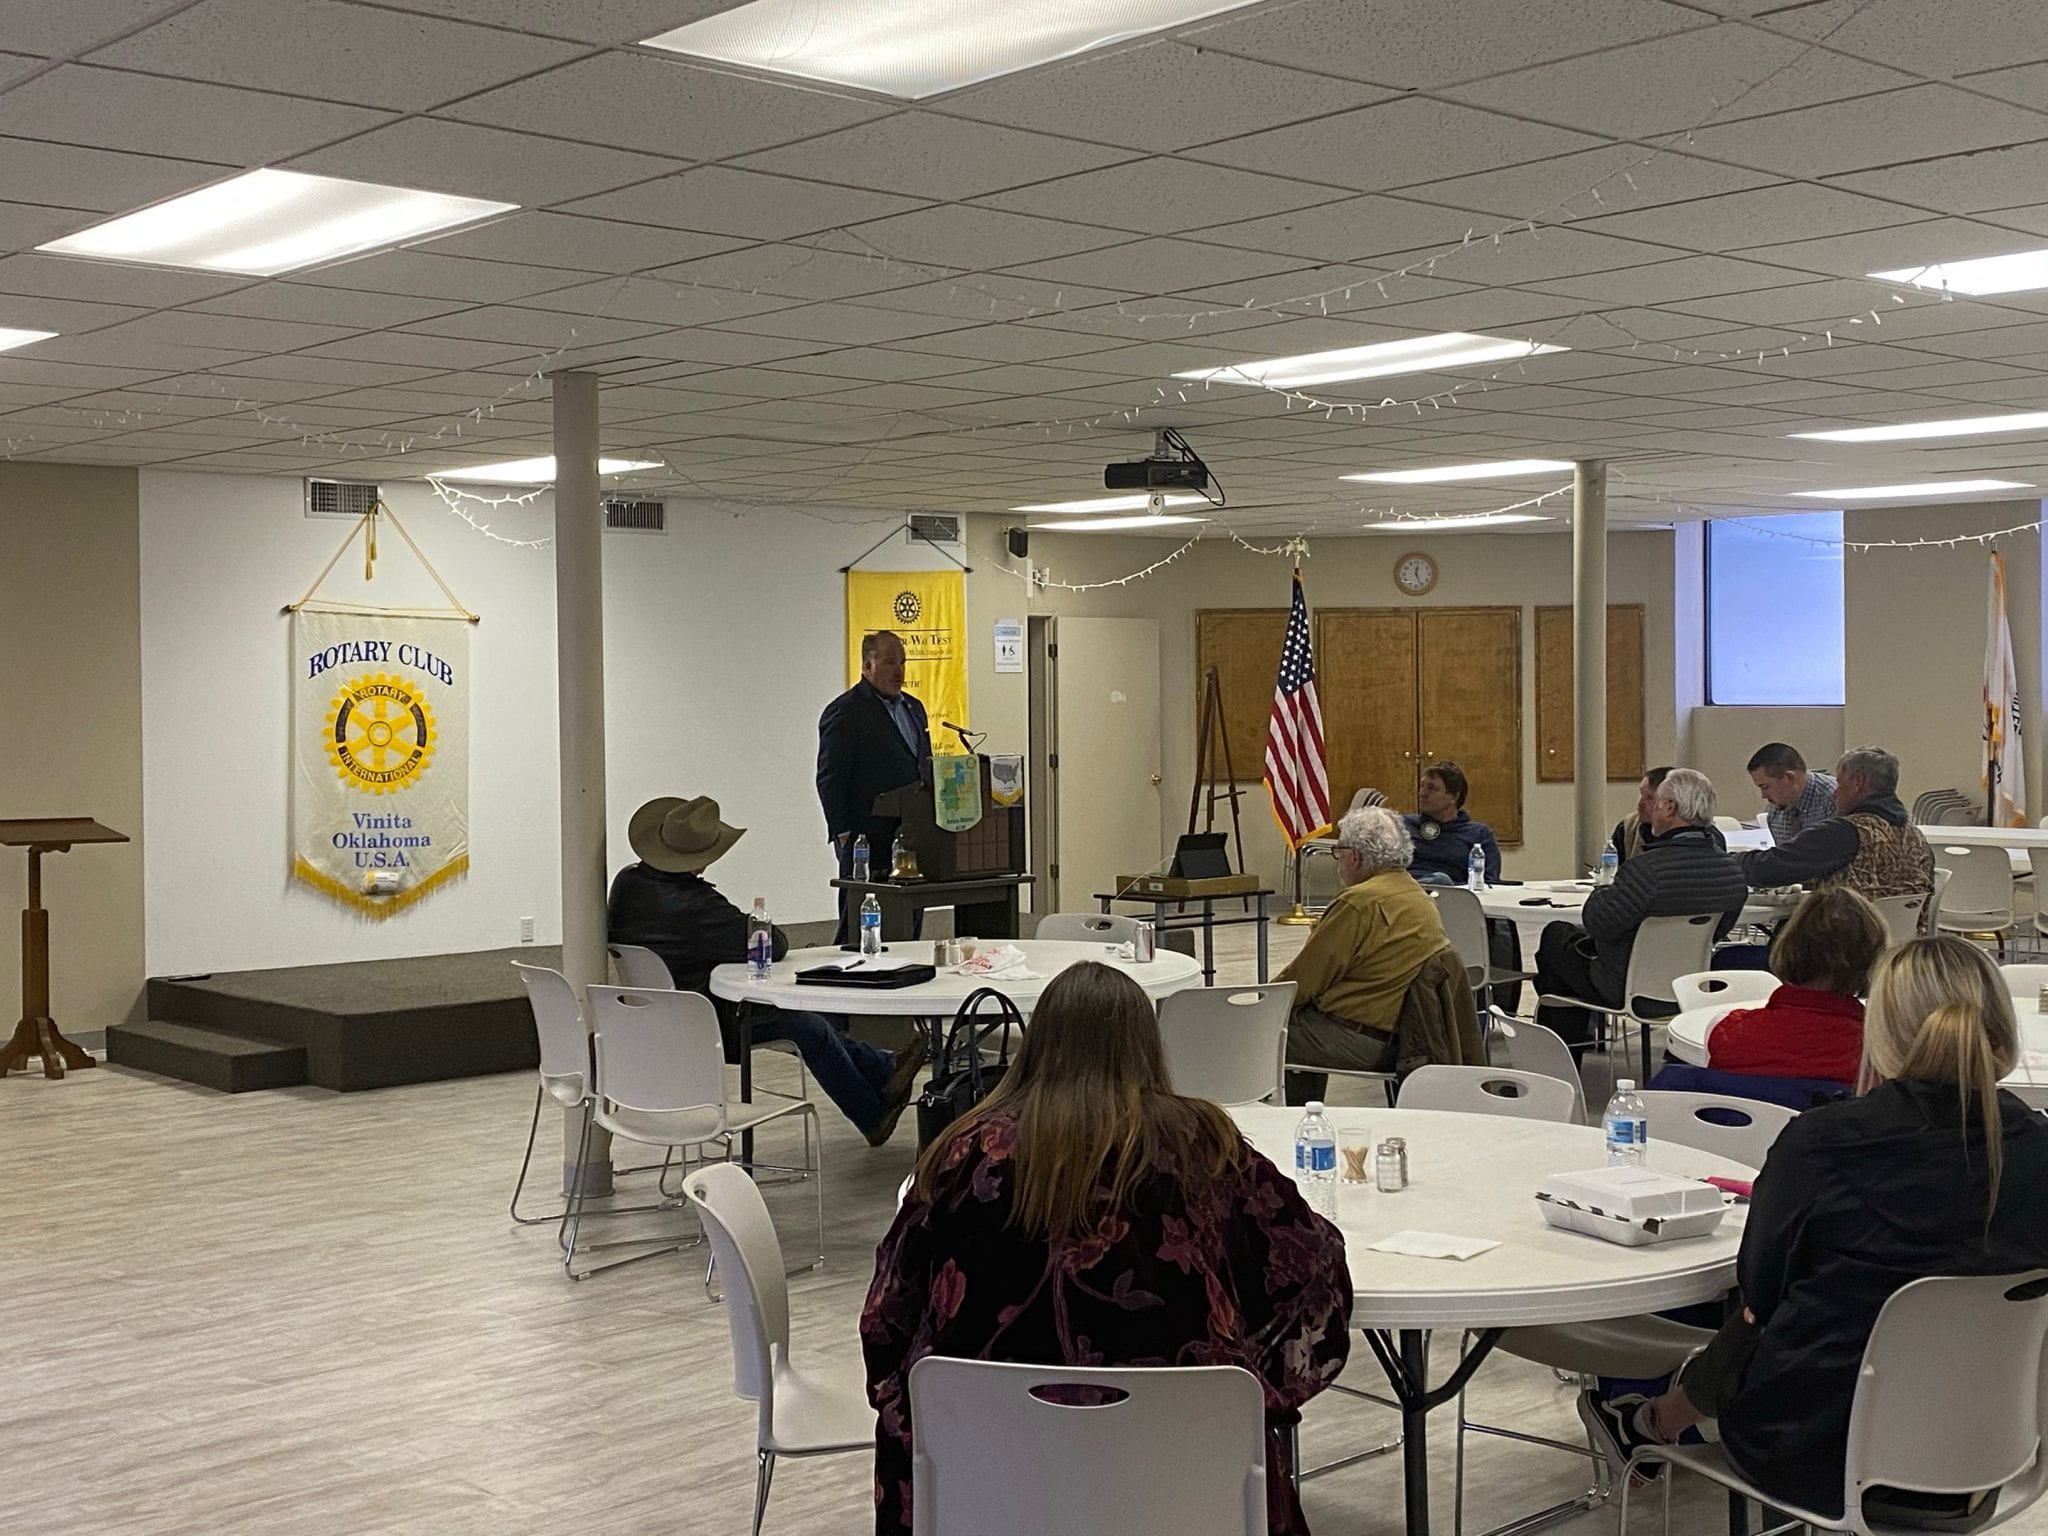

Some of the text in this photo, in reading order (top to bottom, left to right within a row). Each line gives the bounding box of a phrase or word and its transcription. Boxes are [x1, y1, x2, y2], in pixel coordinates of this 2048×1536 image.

[308, 640, 453, 685] ROTARY CLUB
[359, 686, 406, 700] ROTARY
[341, 751, 420, 782] INTERNATIONAL
[352, 813, 412, 829] Vinita
[332, 832, 431, 849] Oklahoma
[354, 851, 410, 868] U.S.A.
